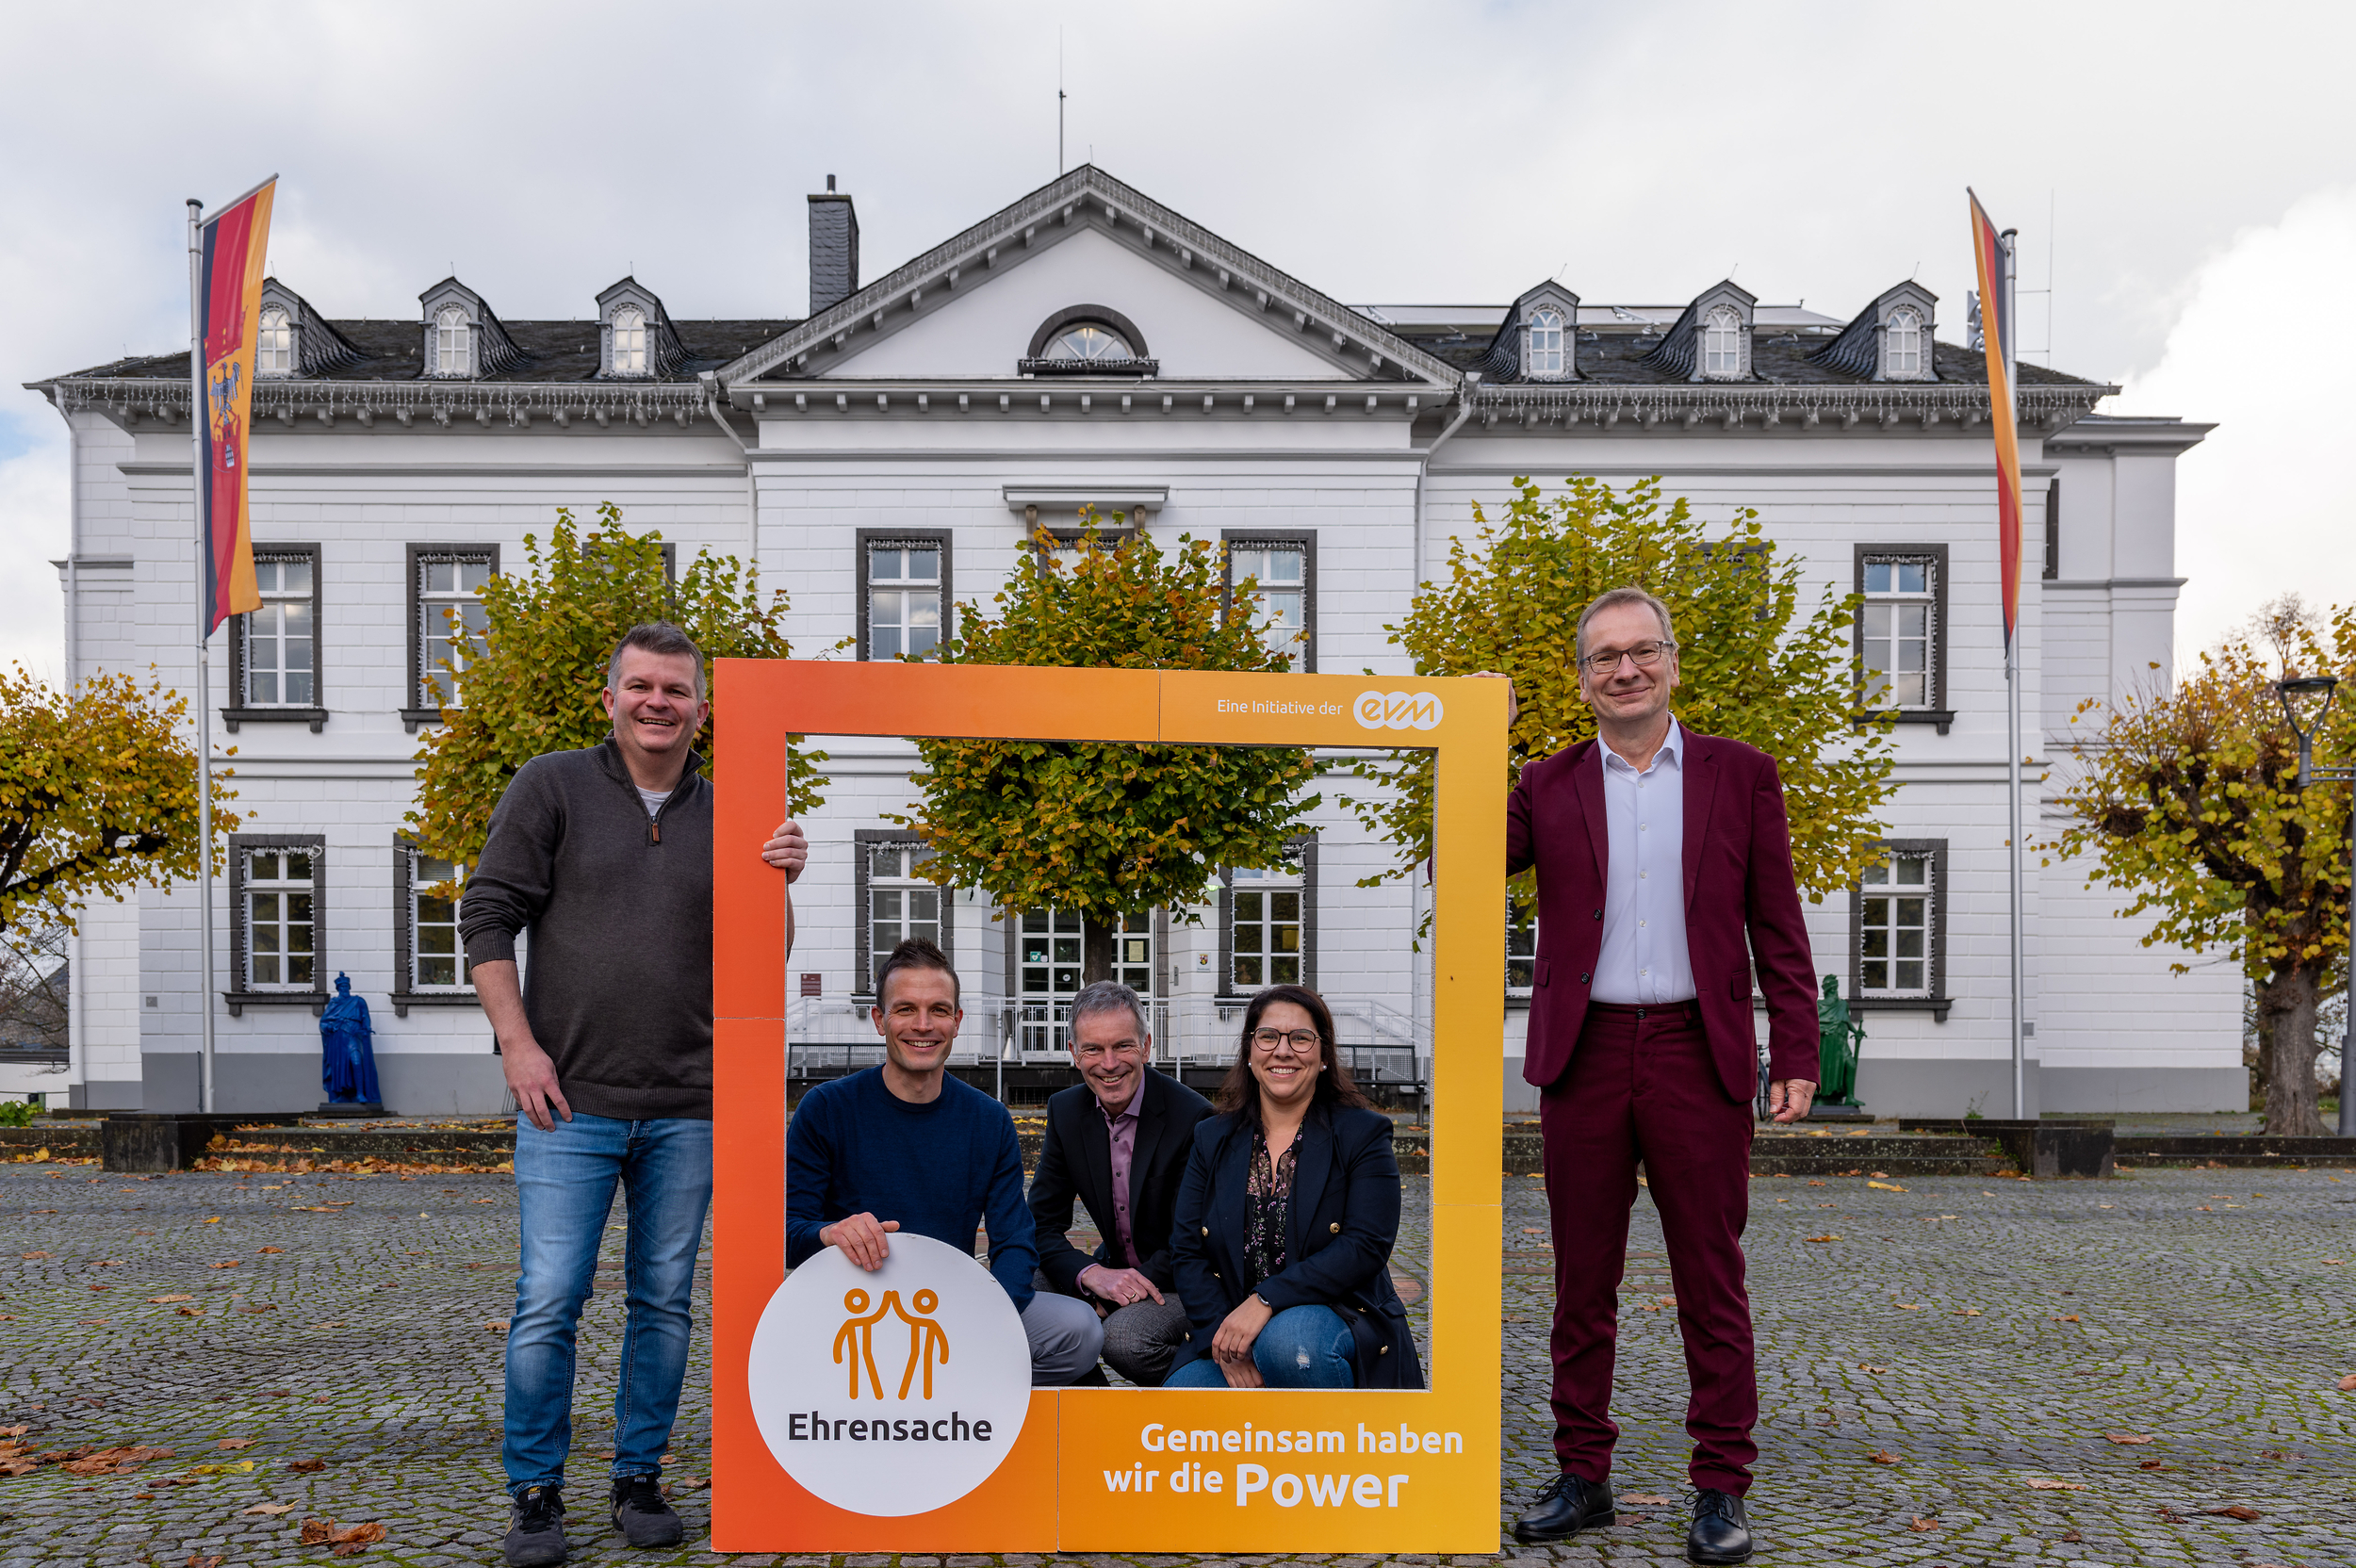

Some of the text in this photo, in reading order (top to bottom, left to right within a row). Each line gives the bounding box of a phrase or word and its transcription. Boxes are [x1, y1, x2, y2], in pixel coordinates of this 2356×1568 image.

[1218, 698, 1434, 722] Eine Initiative der evm
[788, 1411, 992, 1442] Ehrensache
[1140, 1422, 1463, 1454] Gemeinsam haben
[1104, 1462, 1410, 1509] wir die Power
